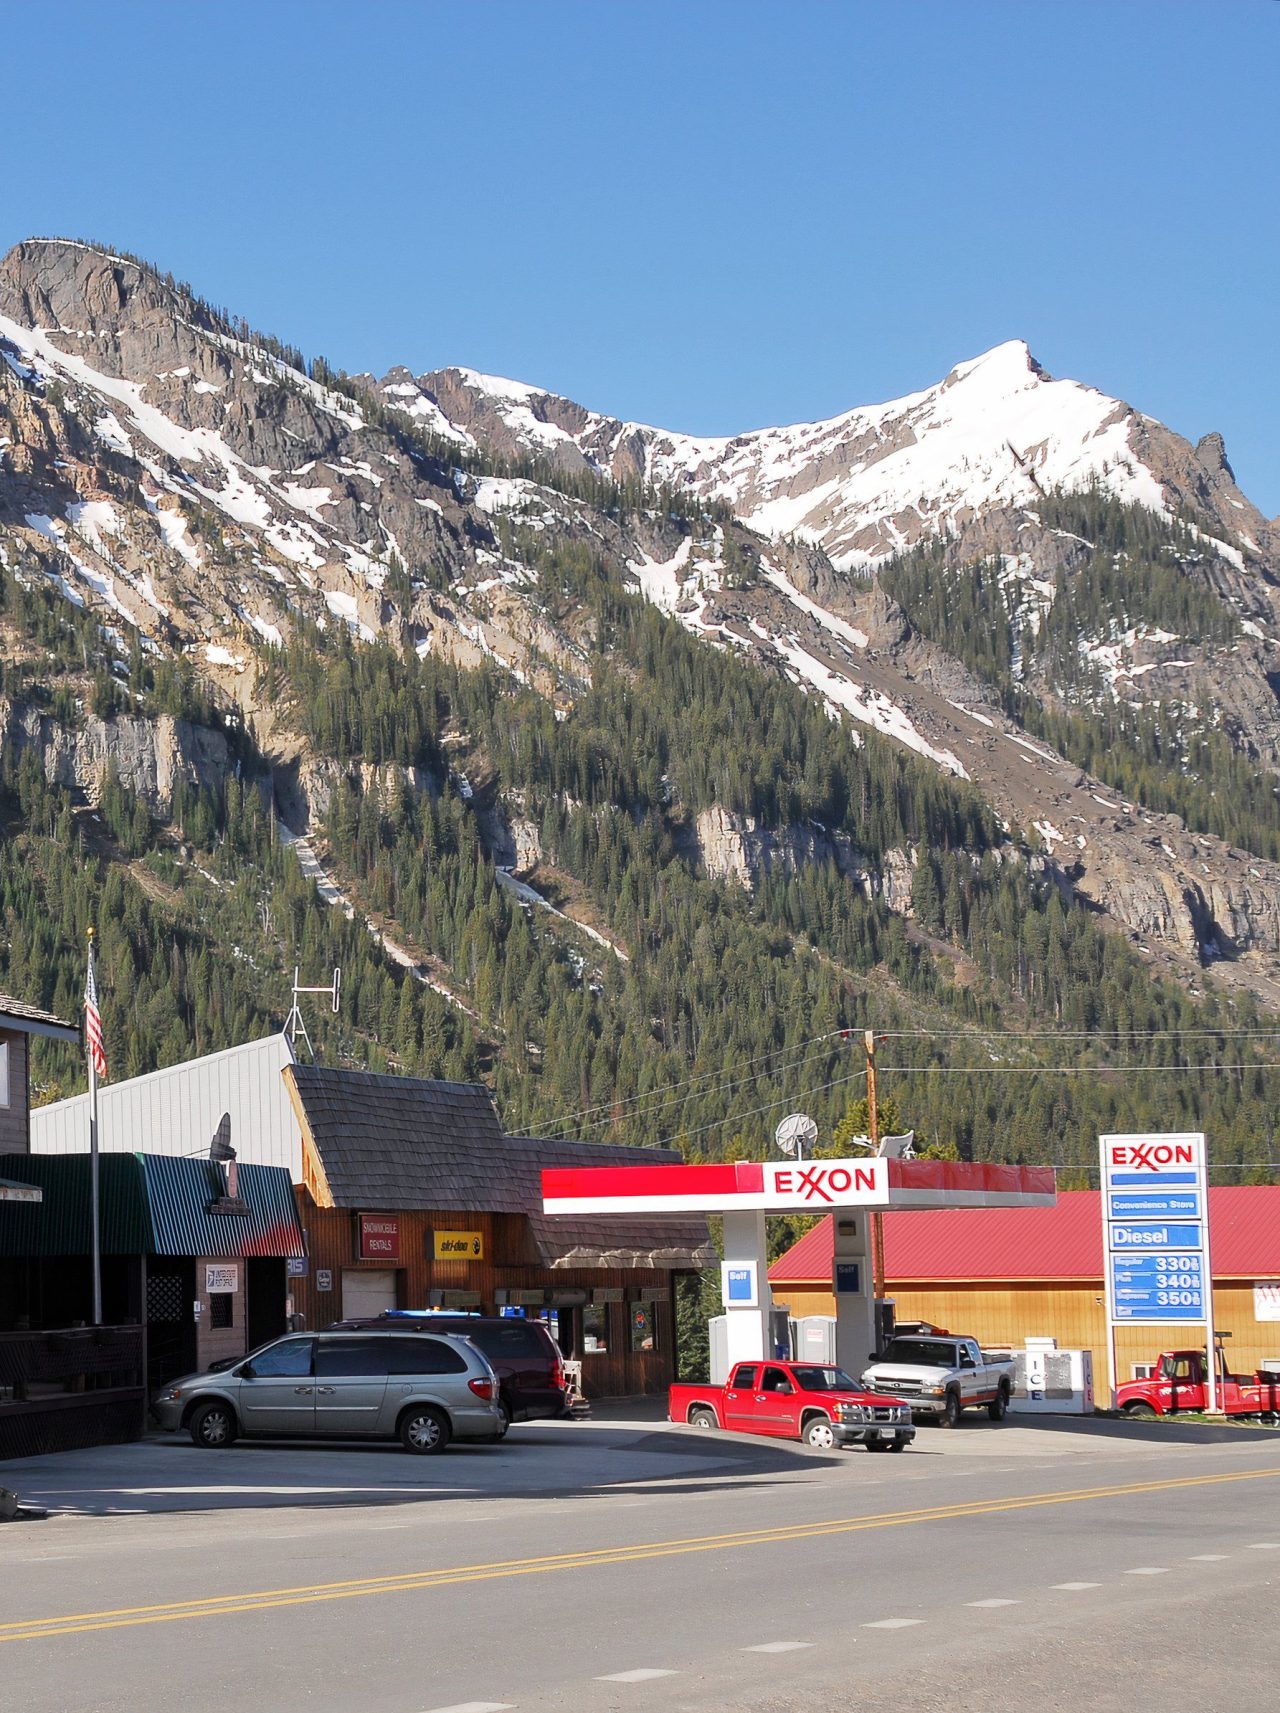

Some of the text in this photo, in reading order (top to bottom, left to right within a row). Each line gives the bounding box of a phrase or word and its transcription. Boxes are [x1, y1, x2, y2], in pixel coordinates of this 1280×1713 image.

[1112, 1143, 1193, 1172] EXXON
[775, 1166, 876, 1202] EXXON
[1170, 1200, 1195, 1209] Store
[363, 1222, 397, 1234] SNOWMOBILE
[1114, 1228, 1169, 1244] Diesel
[369, 1239, 392, 1251] RENTALS
[729, 1271, 747, 1280] Self
